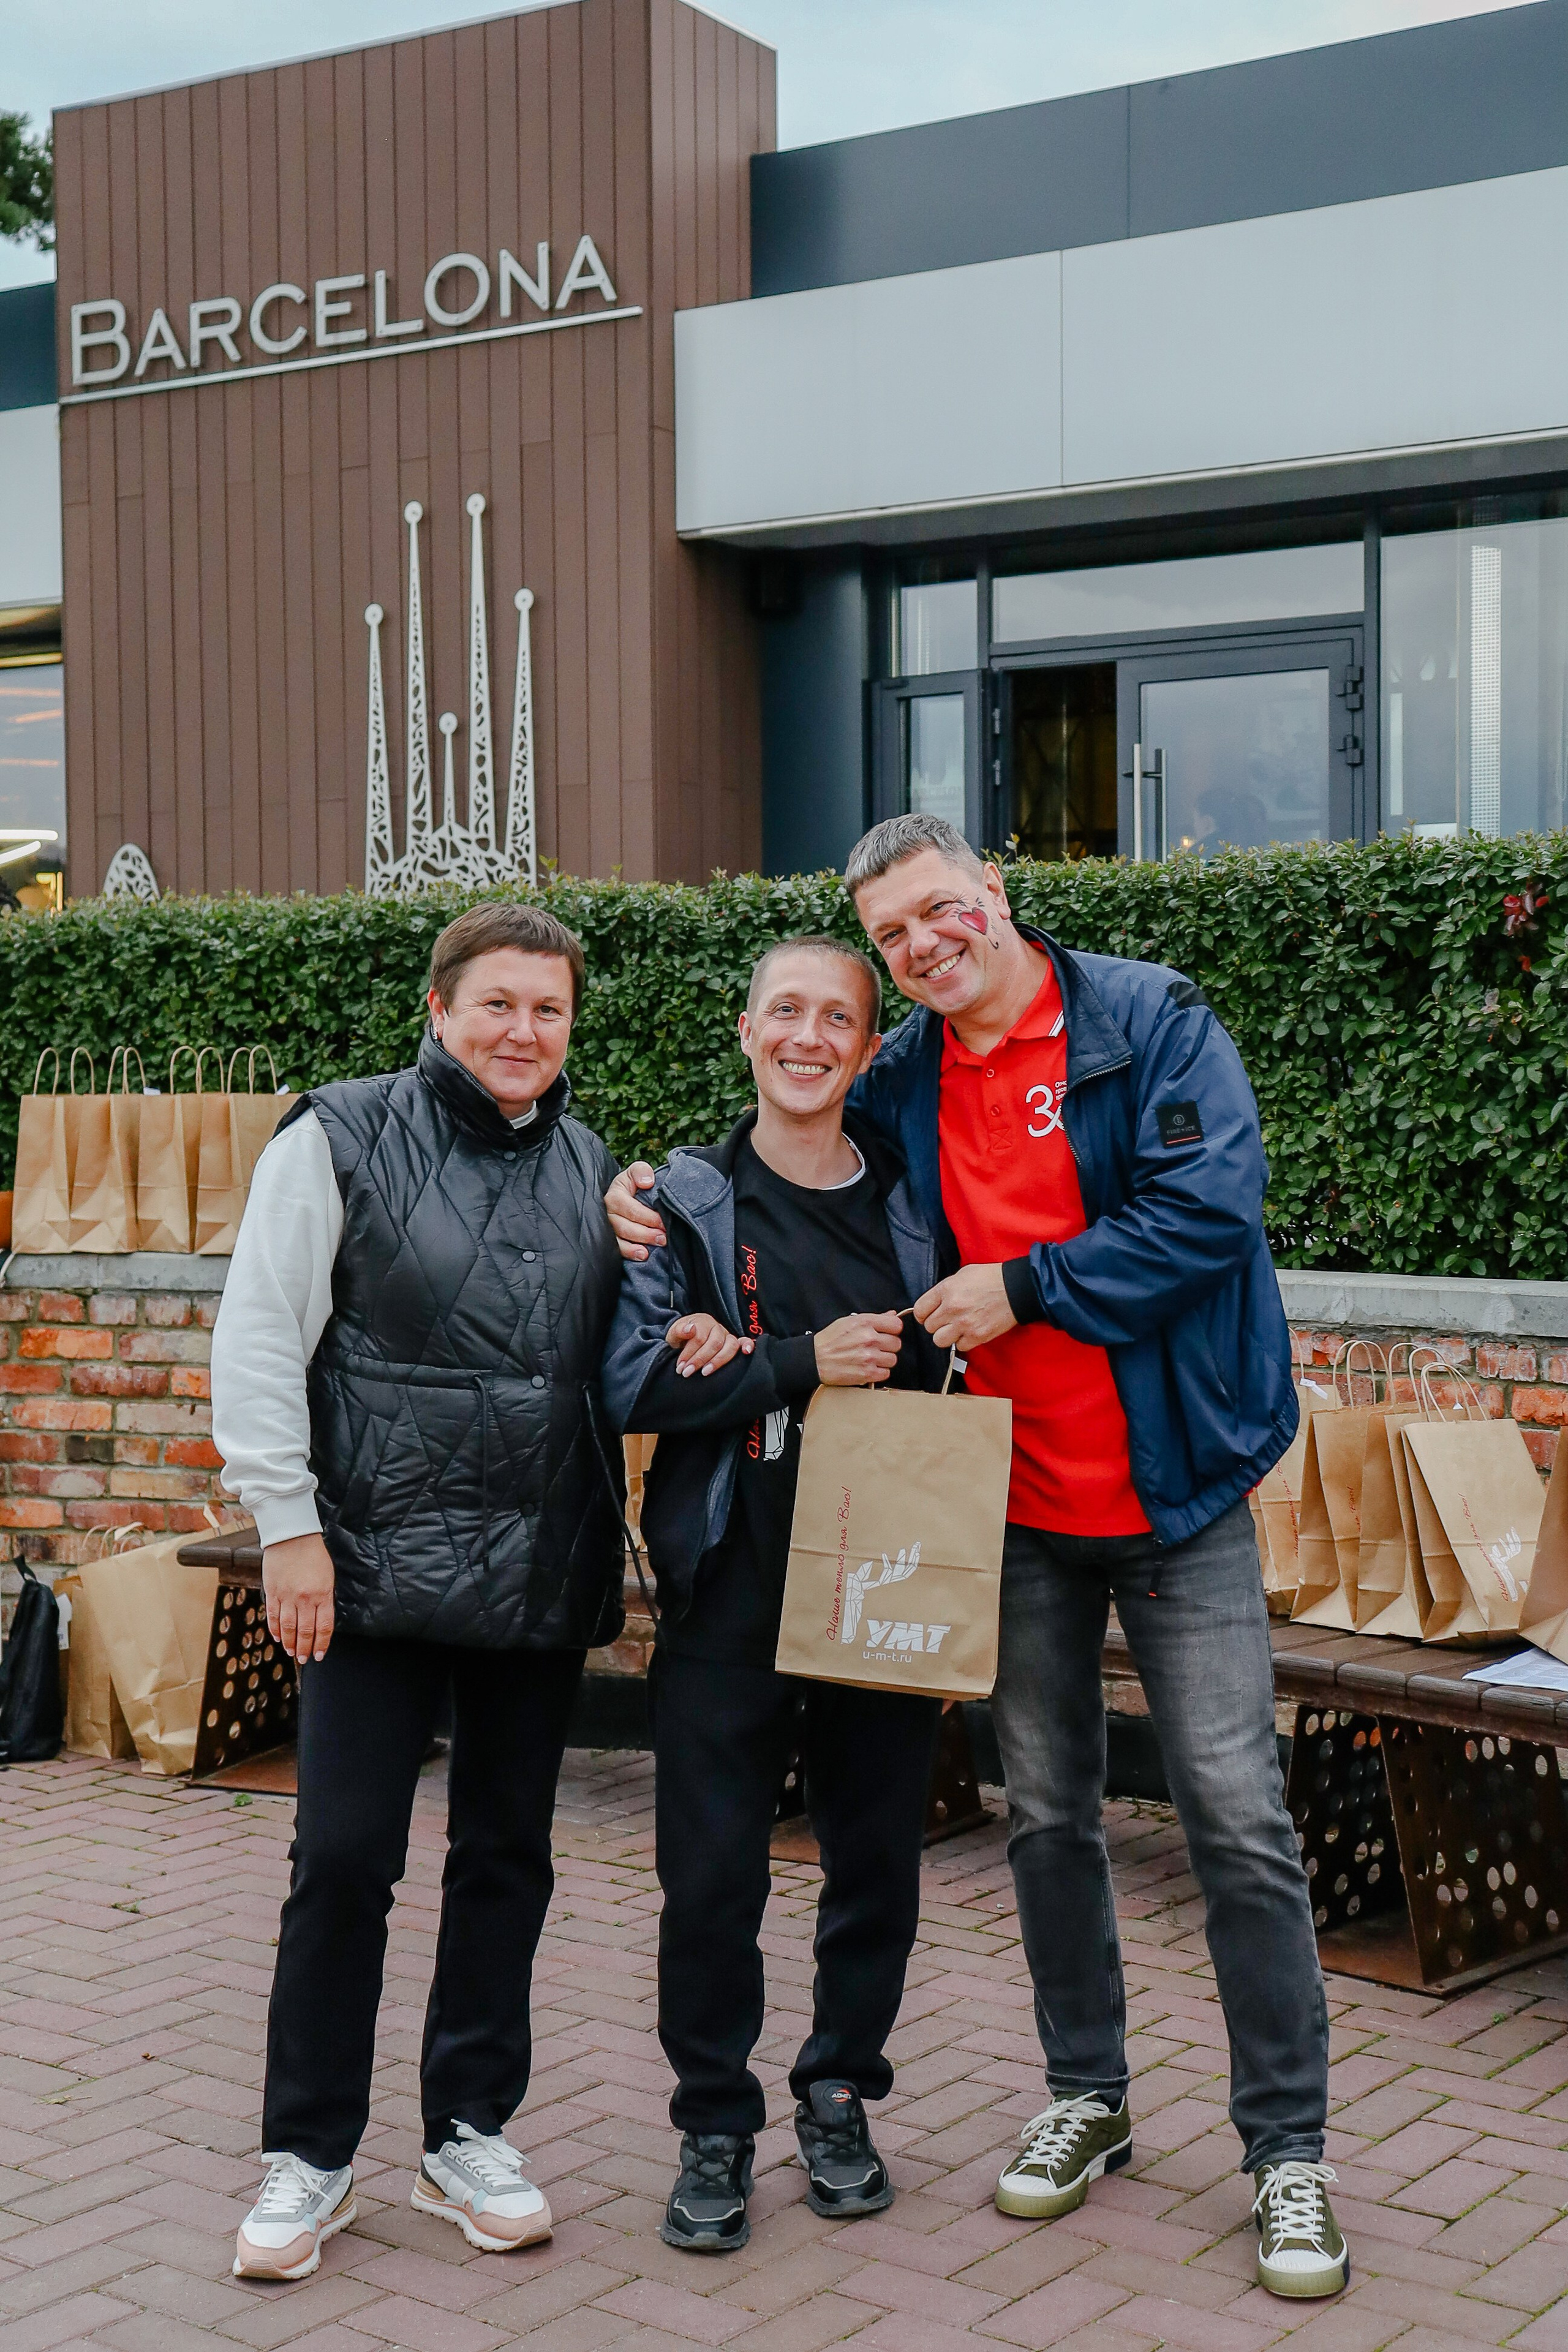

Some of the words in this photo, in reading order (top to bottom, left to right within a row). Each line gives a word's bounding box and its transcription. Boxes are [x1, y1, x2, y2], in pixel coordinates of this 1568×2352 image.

[70, 235, 617, 386] BARCELONA
[837, 1485, 852, 1523] Вас!
[839, 1526, 849, 1551] для
[834, 1553, 845, 1594] тепло
[826, 1597, 841, 1641] Наше
[862, 1651, 913, 1663] u-m-t.ru
